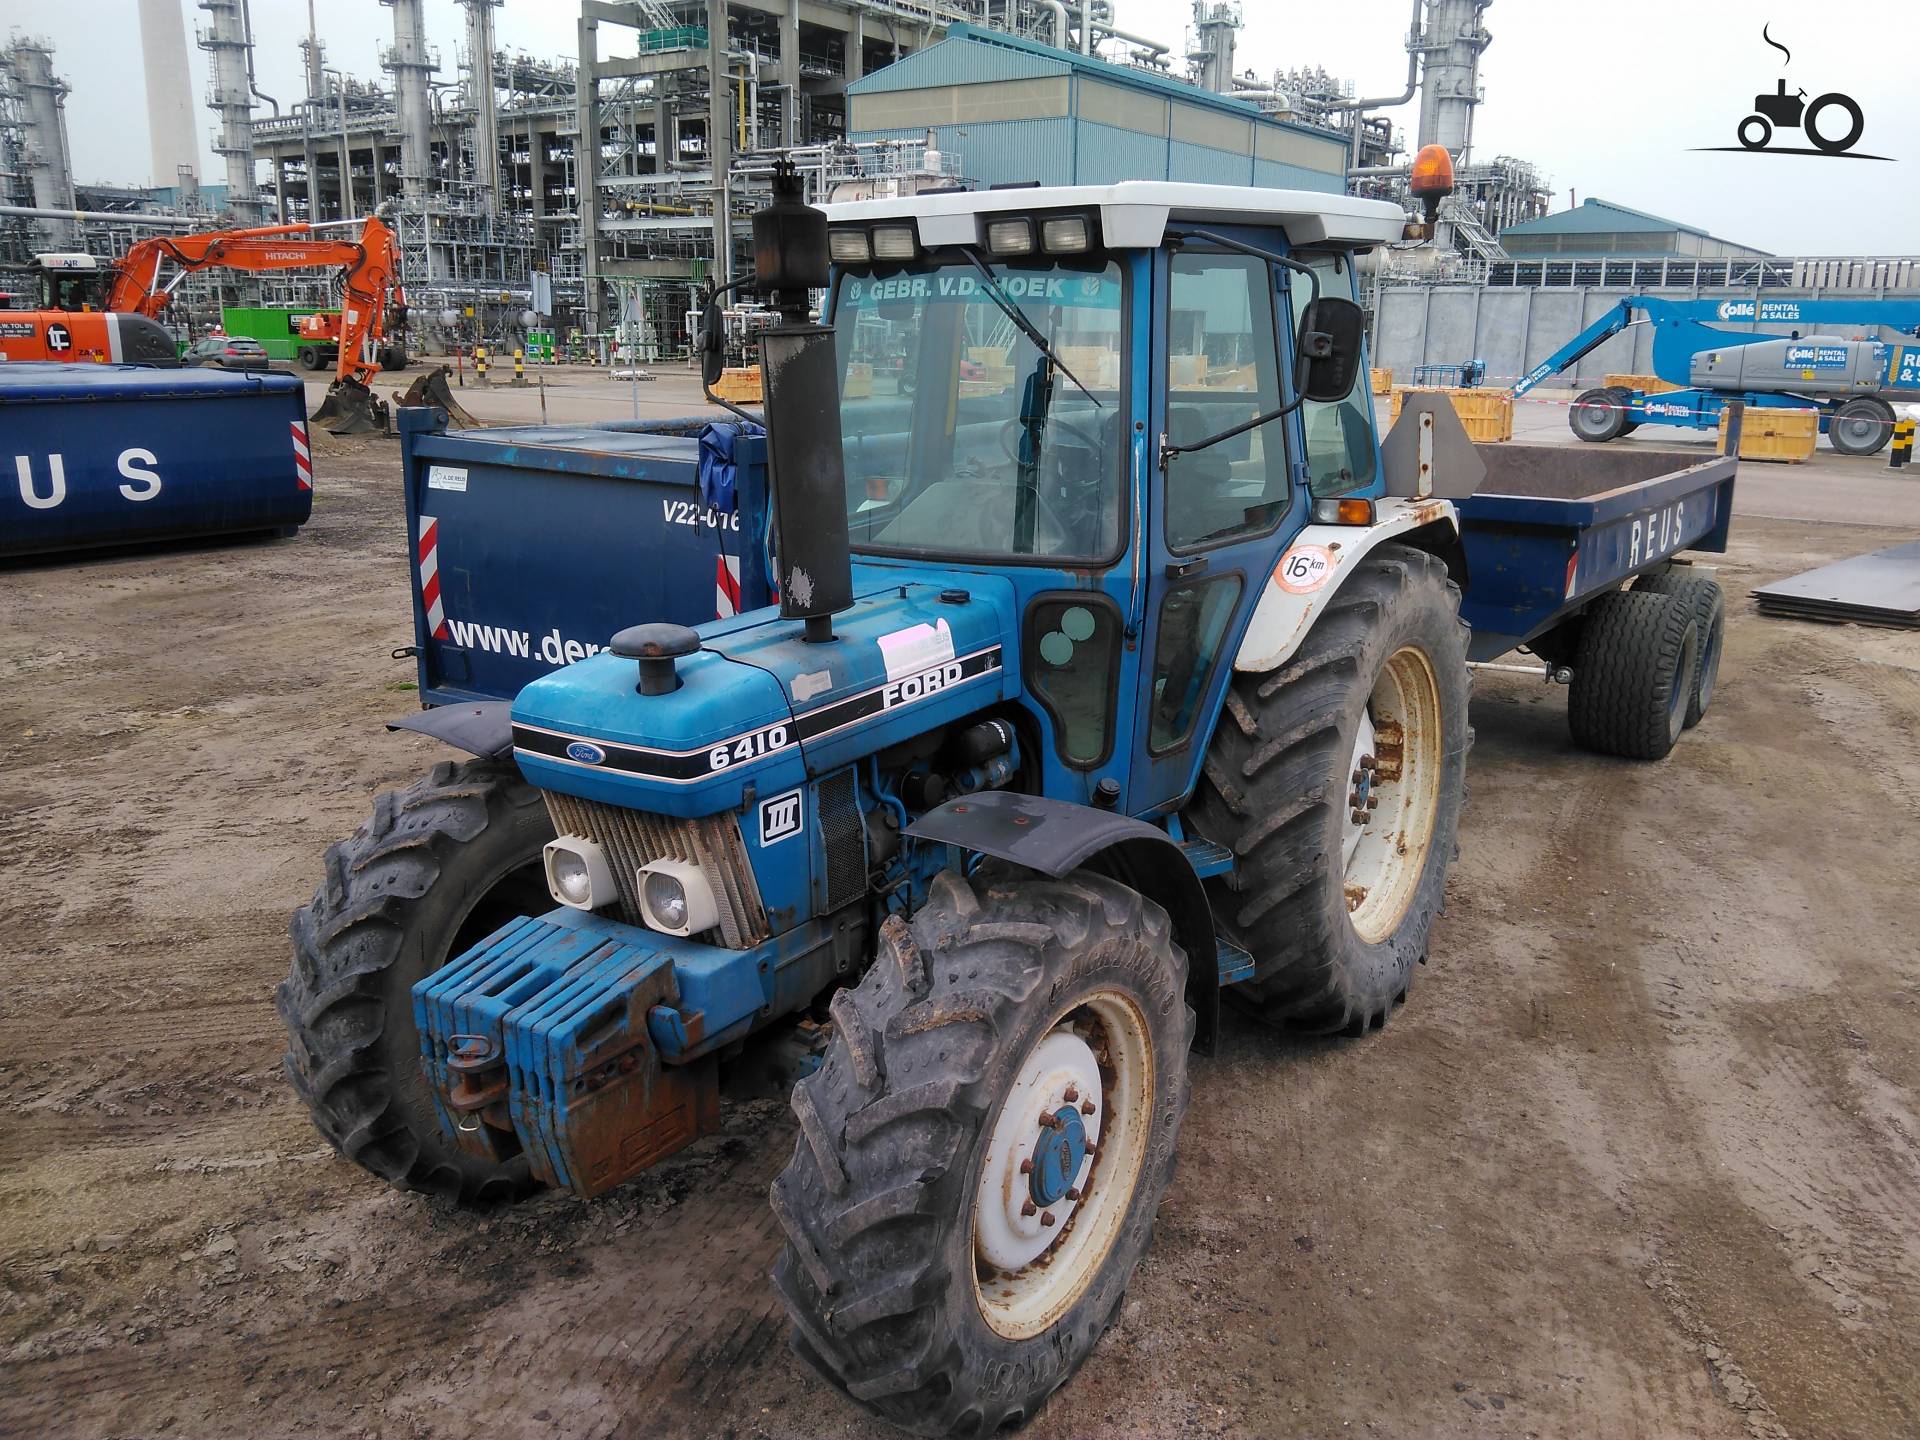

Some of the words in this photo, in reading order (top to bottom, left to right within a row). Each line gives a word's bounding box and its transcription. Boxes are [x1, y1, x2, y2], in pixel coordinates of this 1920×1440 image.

[265, 252, 306, 260] HITACHI
[870, 277, 932, 300] GEBR.
[938, 276, 980, 297] V.D.
[1719, 301, 1755, 320] Collé
[1761, 303, 1800, 311] RENTAL
[1761, 311, 1769, 320] &
[1769, 311, 1800, 320] SALES
[1628, 501, 1684, 569] REUS
[1286, 555, 1310, 578] 16
[1309, 559, 1325, 570] km
[882, 663, 963, 710] FORD
[709, 726, 788, 771] 6410
